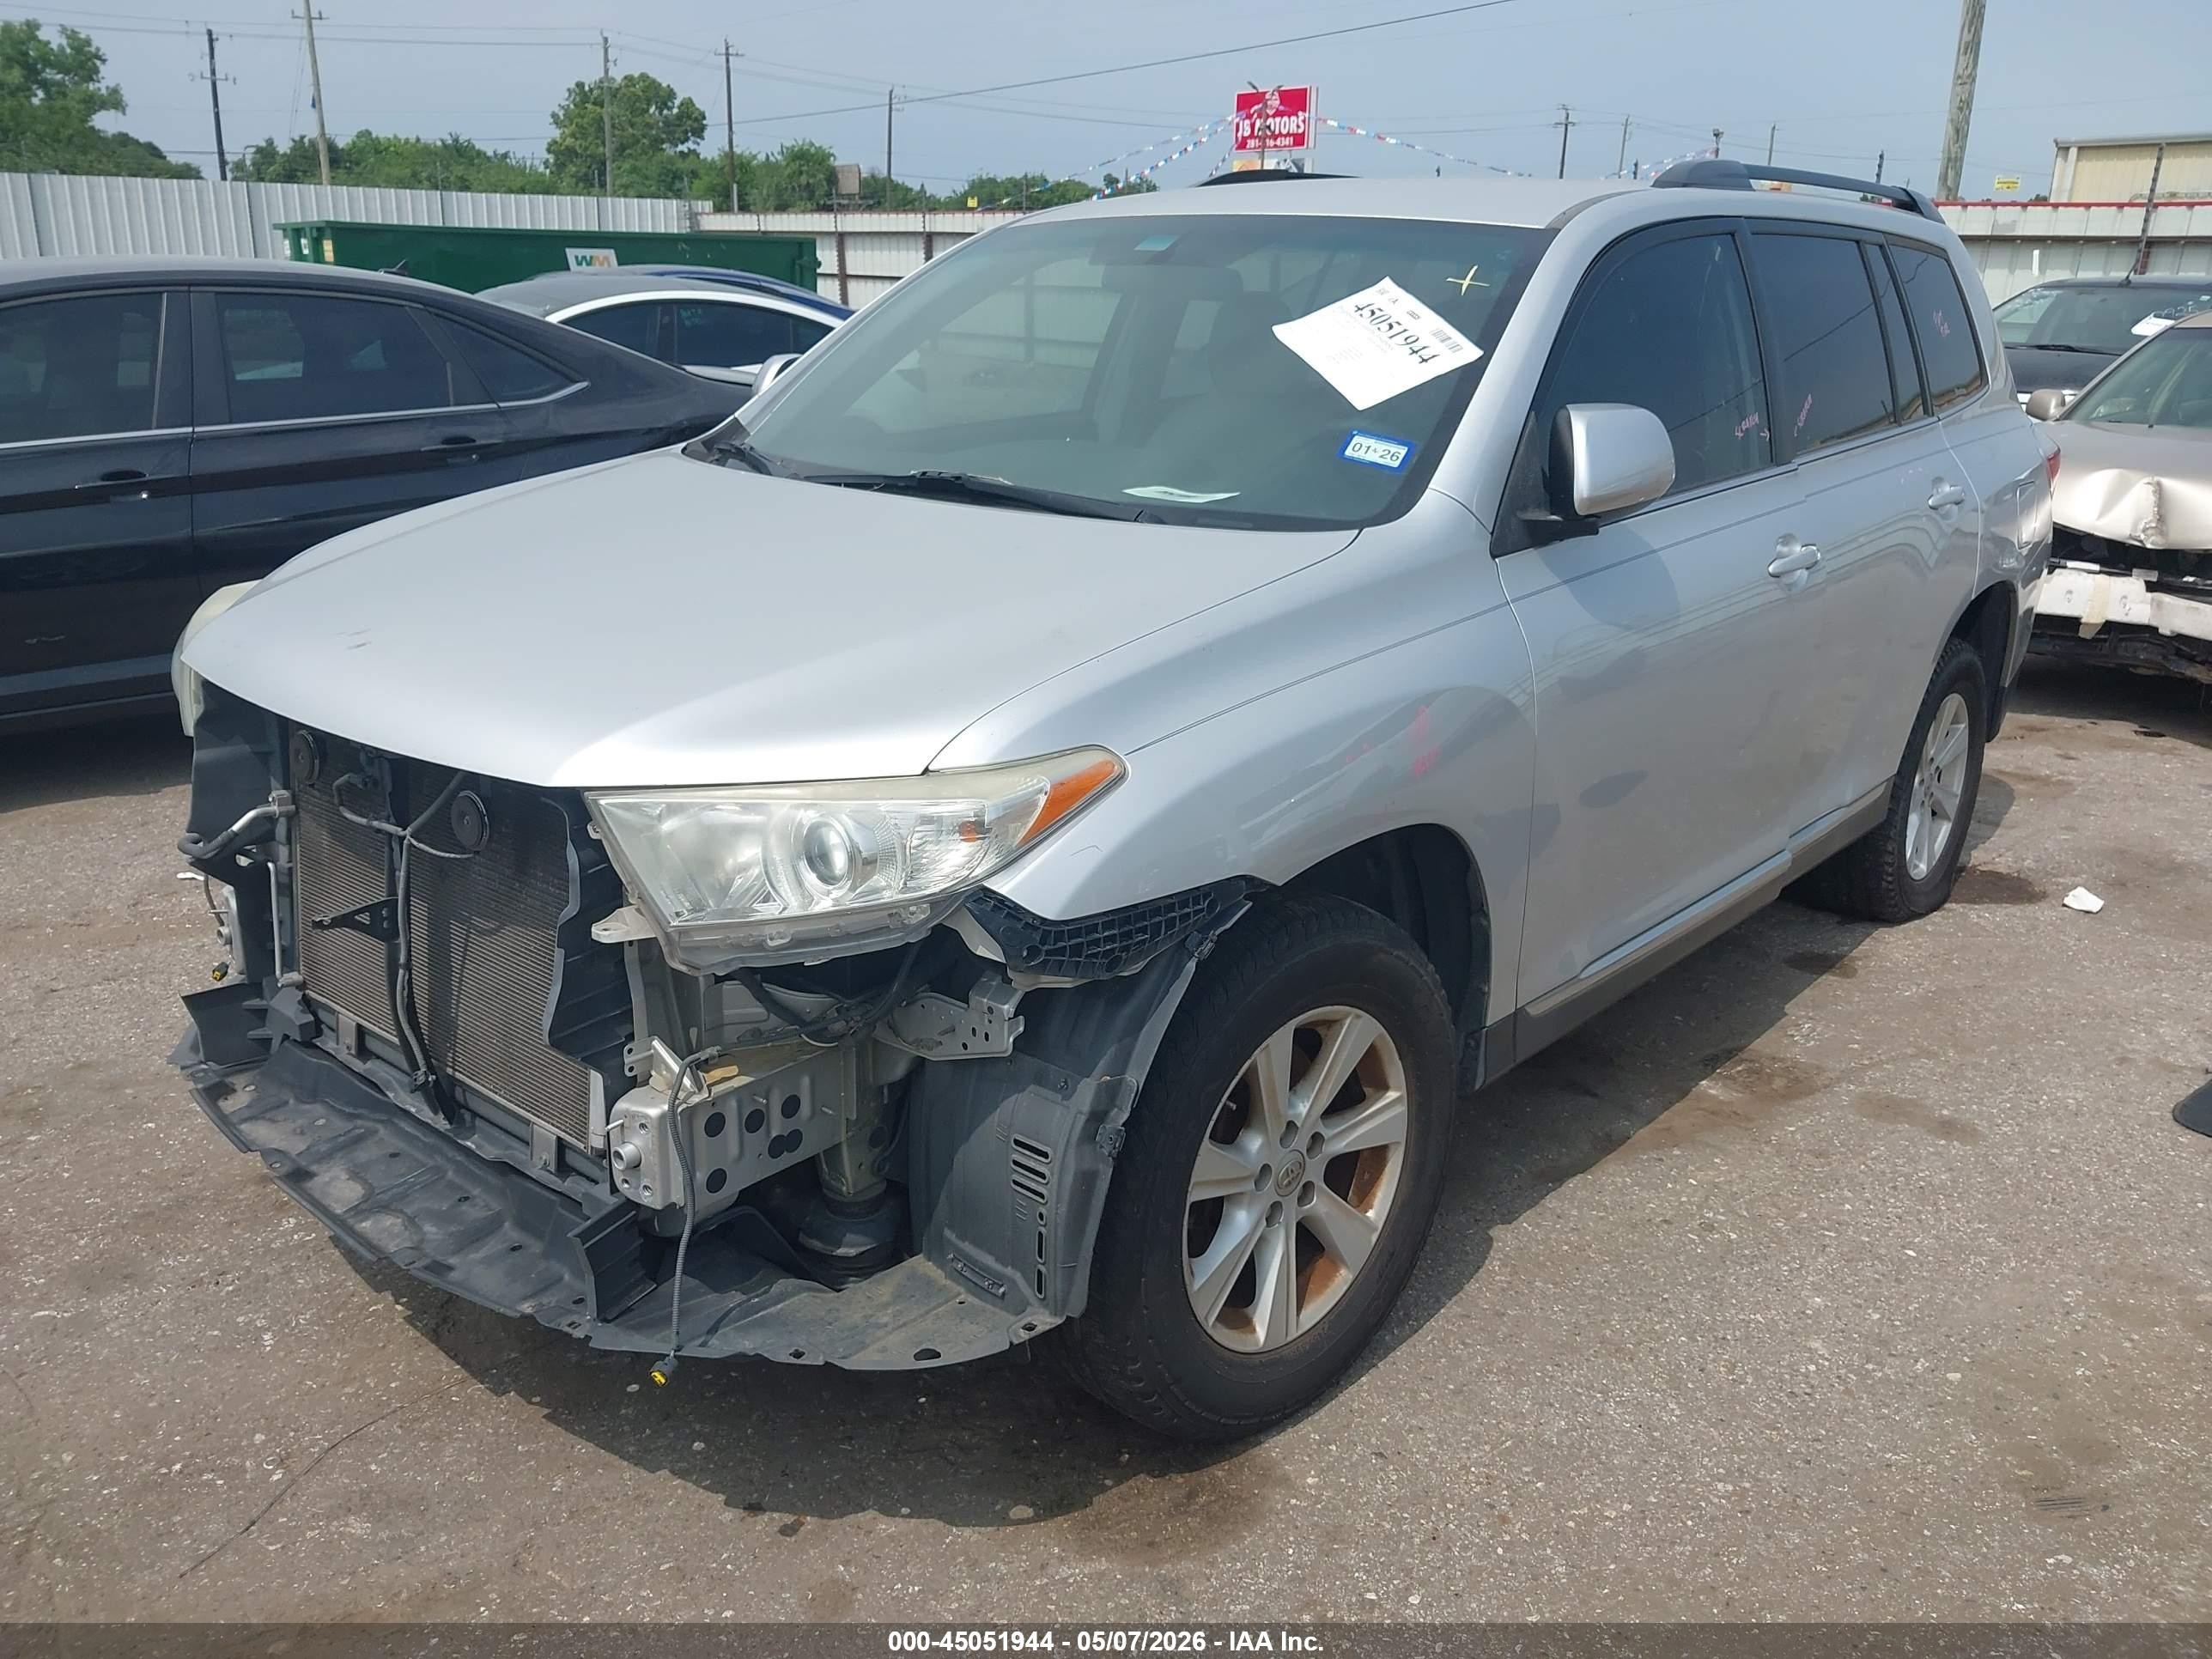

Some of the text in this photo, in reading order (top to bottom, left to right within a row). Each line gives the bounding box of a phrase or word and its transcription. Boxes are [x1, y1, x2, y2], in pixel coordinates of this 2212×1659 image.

[574, 254, 611, 268] WM
[1353, 301, 1440, 365] 45051944
[1352, 442, 1371, 455] 01
[1378, 448, 1401, 462] 26
